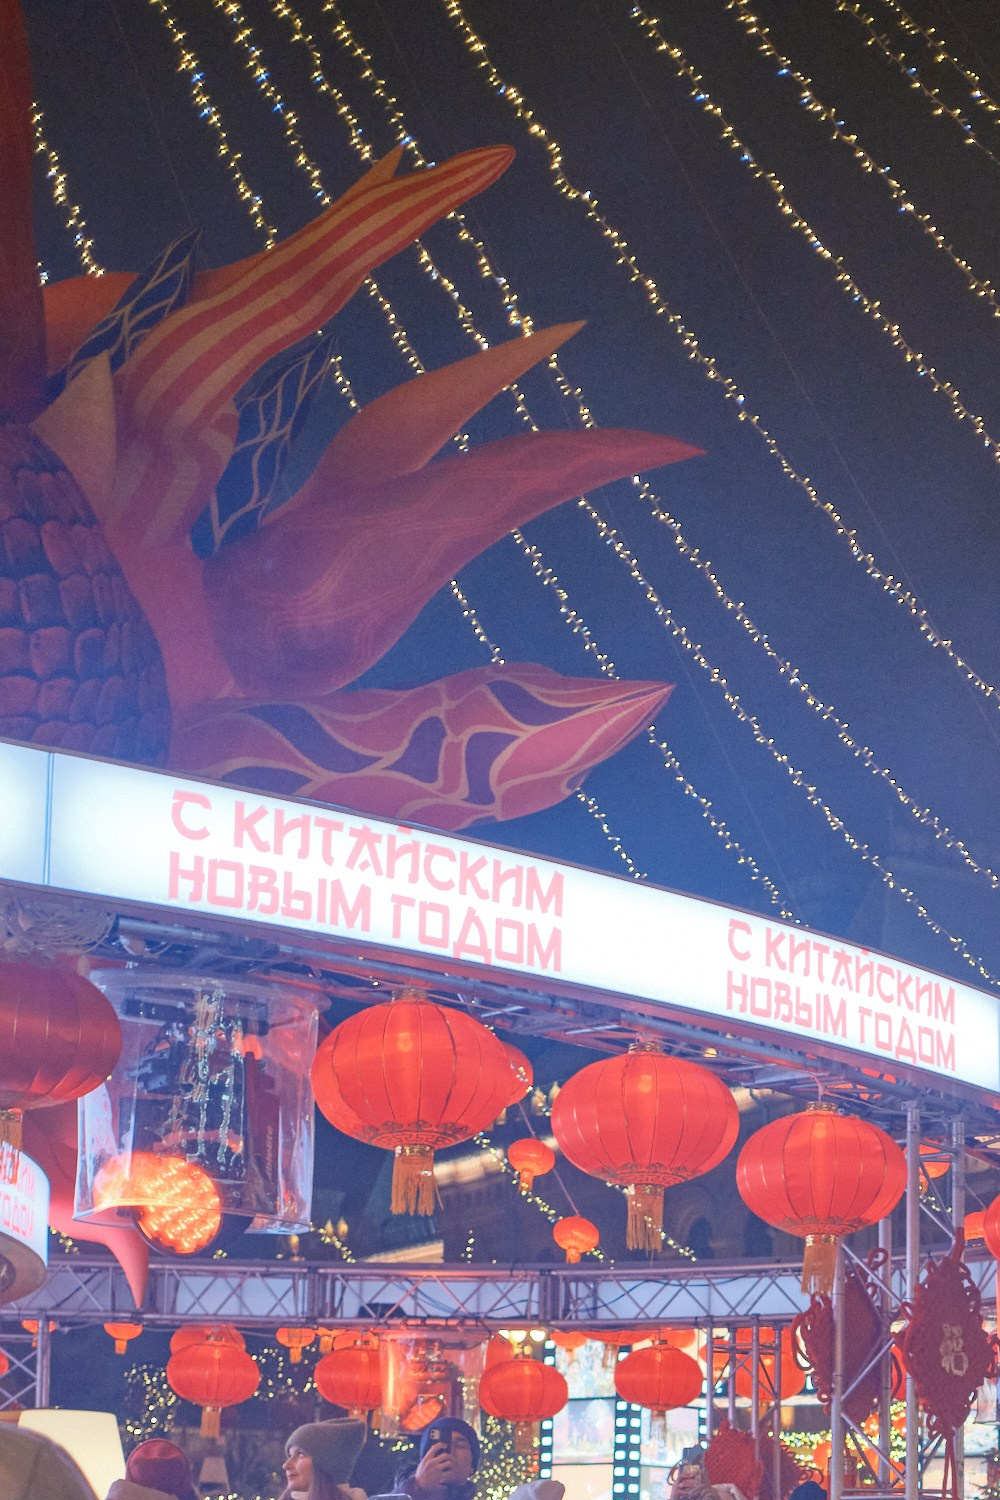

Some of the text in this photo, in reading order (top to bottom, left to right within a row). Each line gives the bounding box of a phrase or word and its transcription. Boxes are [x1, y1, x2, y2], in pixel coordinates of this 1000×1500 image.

[171, 789, 564, 917] С КИТАЙСКИМ
[167, 850, 562, 972] НОВЫМ ГОДОМ
[726, 970, 956, 1071] НОВЫМ ГОДОМ
[728, 918, 956, 1025] С КИТАЙСКИМ
